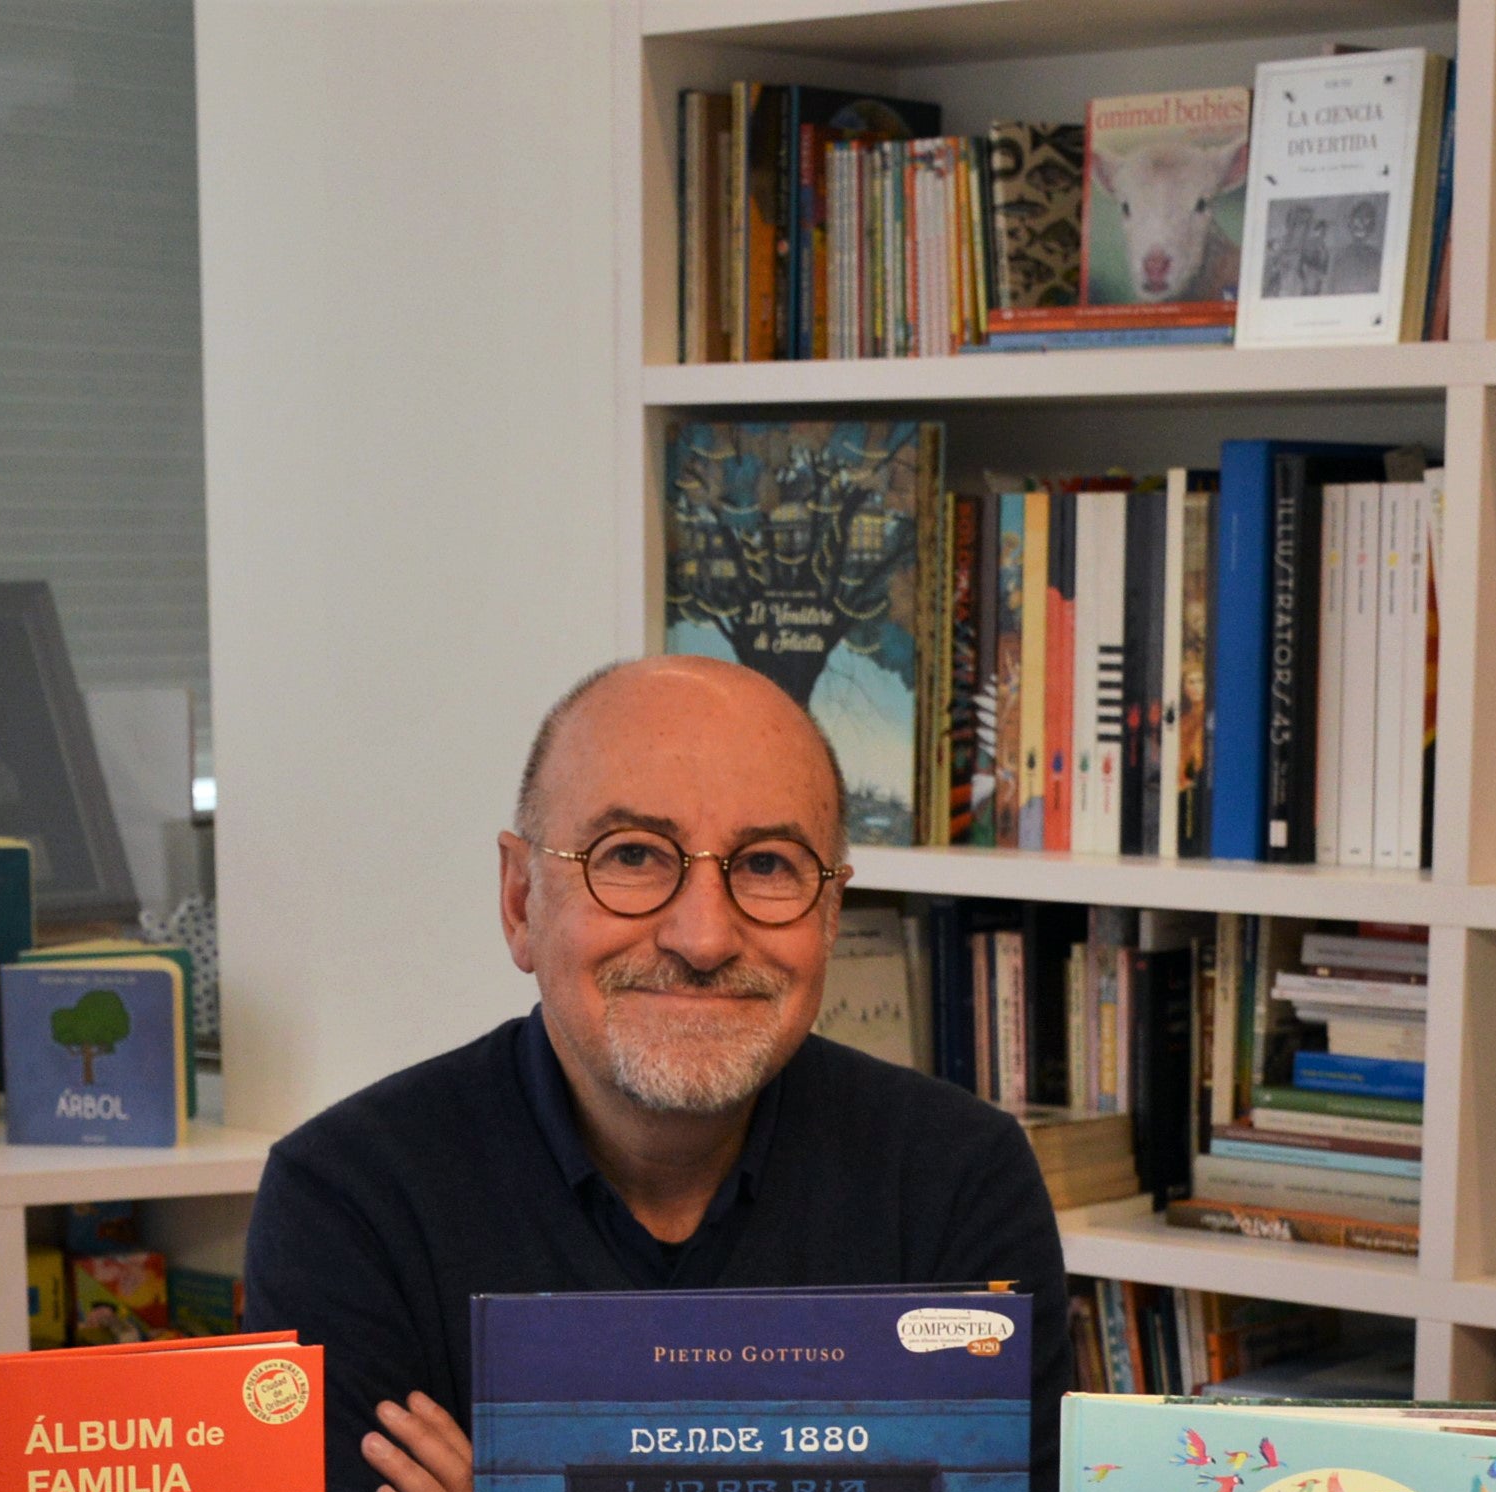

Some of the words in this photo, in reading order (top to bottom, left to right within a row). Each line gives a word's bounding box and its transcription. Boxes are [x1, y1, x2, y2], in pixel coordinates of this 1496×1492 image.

[1095, 101, 1172, 131] animal
[1176, 95, 1247, 126] babies
[1287, 110, 1308, 128] LA
[1315, 103, 1385, 126] CIENCIA
[1287, 133, 1378, 157] DIVERTIDA
[1271, 500, 1294, 704] ILLUSTRATORS
[55, 1088, 131, 1121] ÁRBOL
[901, 1322, 1007, 1336] COMPOSTELA
[654, 1346, 731, 1363] PIETRO
[742, 1345, 846, 1363] GOTTUSO
[24, 1415, 173, 1455] ÁLBUM
[186, 1421, 225, 1447] de
[630, 1427, 764, 1454] DENDE
[780, 1426, 868, 1452] 1880
